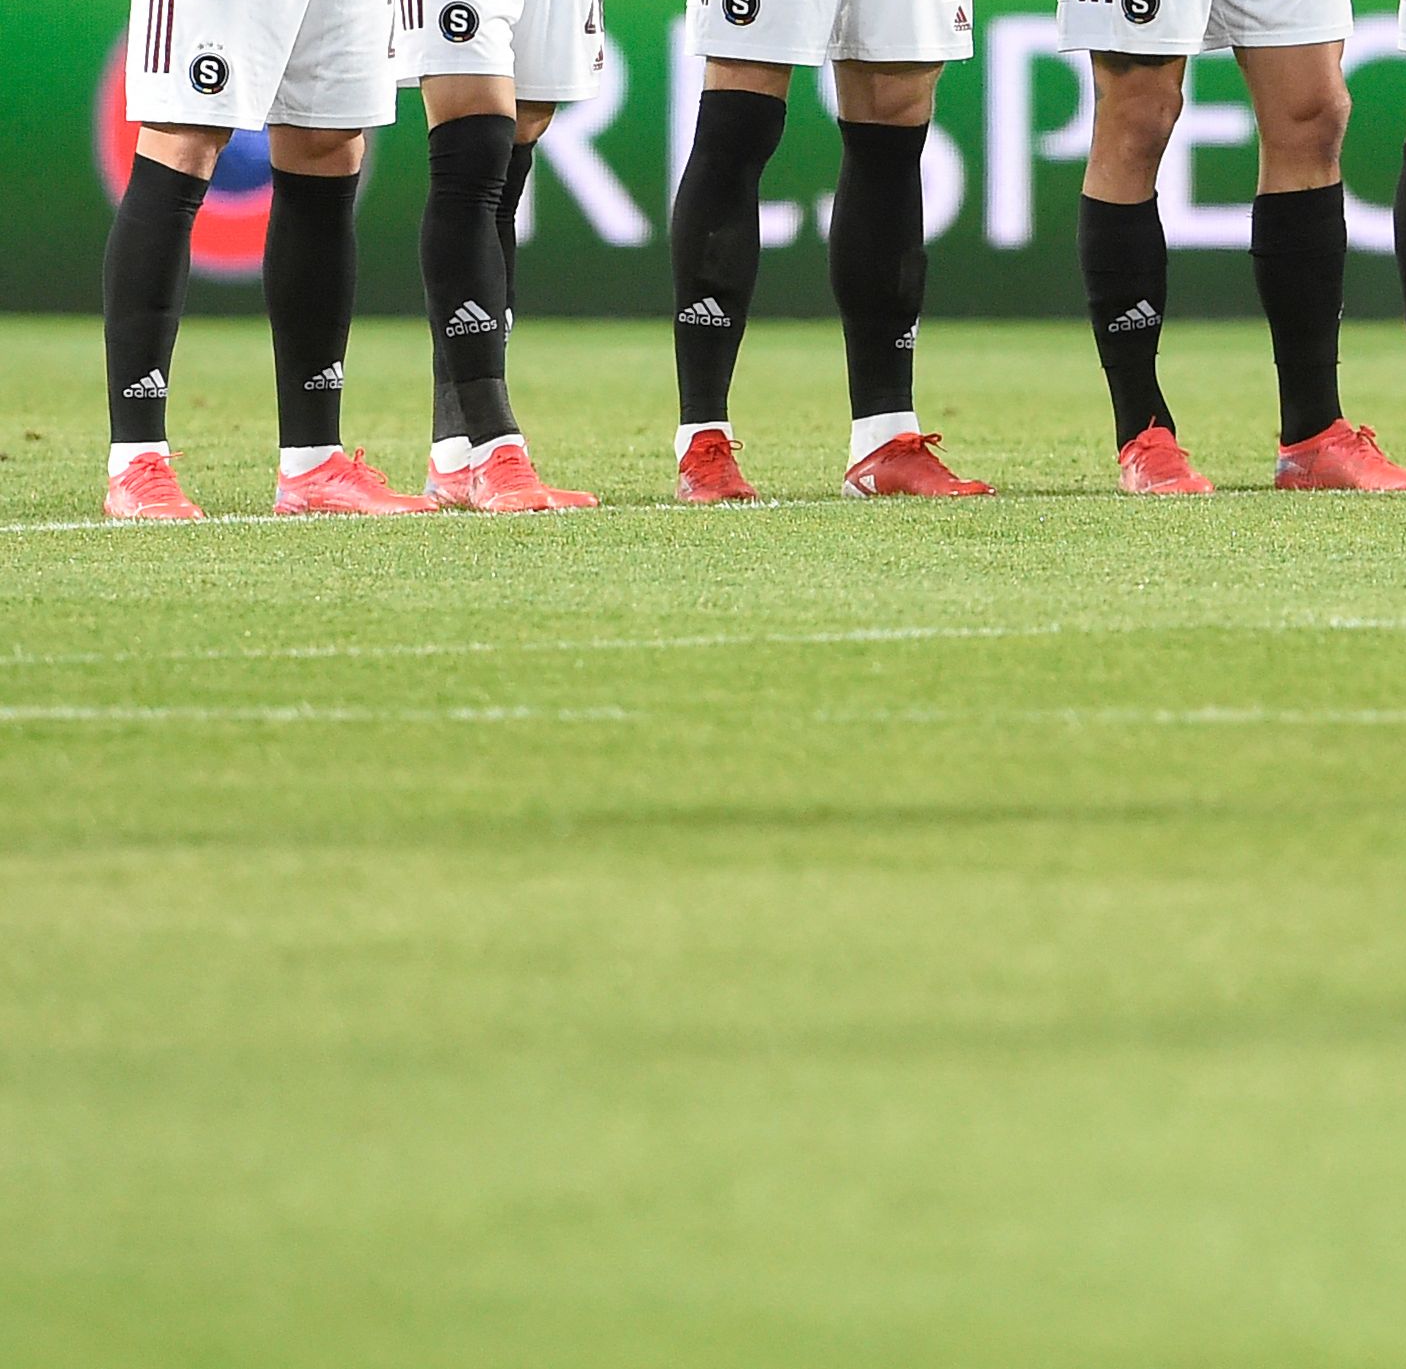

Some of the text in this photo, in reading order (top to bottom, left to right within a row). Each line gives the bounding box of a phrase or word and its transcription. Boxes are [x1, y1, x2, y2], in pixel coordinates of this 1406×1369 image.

[446, 319, 498, 337] adidas
[678, 311, 732, 328] adidas
[1108, 314, 1162, 333] adidas
